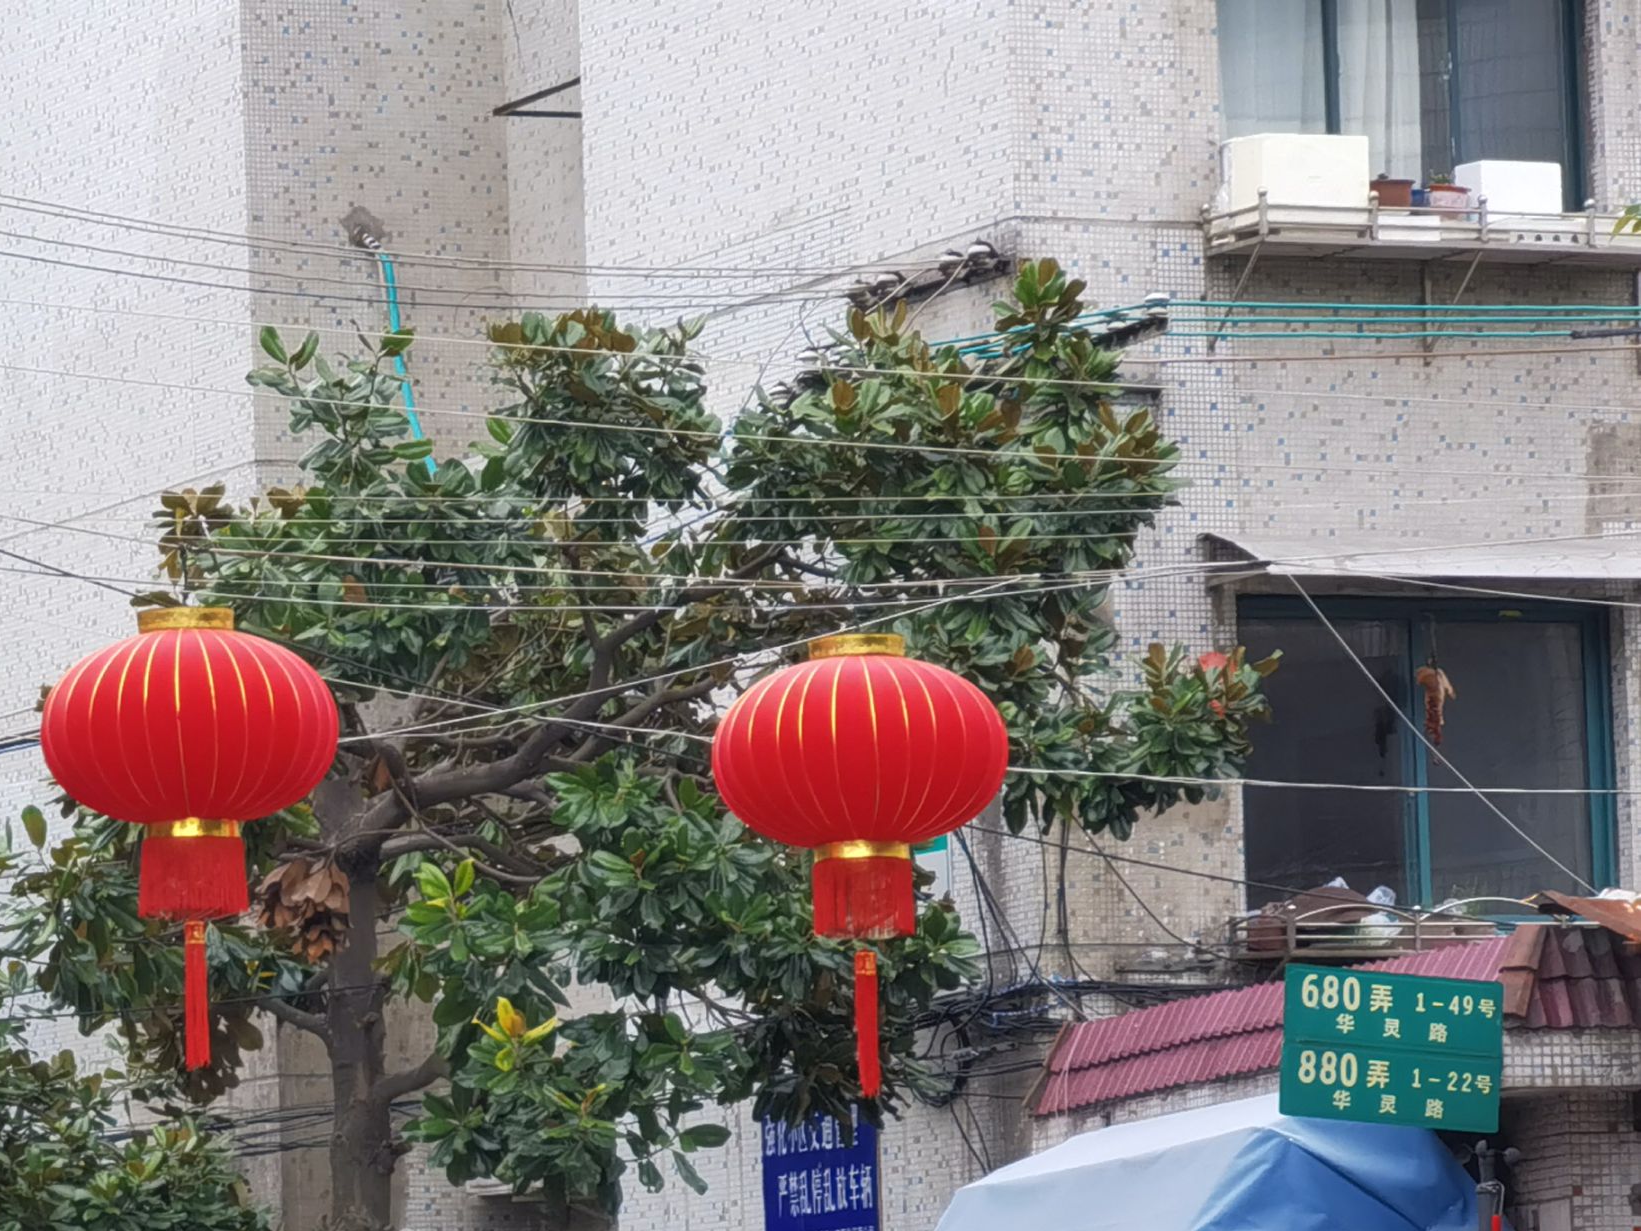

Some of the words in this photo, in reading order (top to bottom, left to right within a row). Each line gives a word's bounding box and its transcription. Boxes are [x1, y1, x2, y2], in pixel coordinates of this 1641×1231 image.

[1336, 1013, 1448, 1043] 华灵路
[1332, 1090, 1444, 1119] 华灵路
